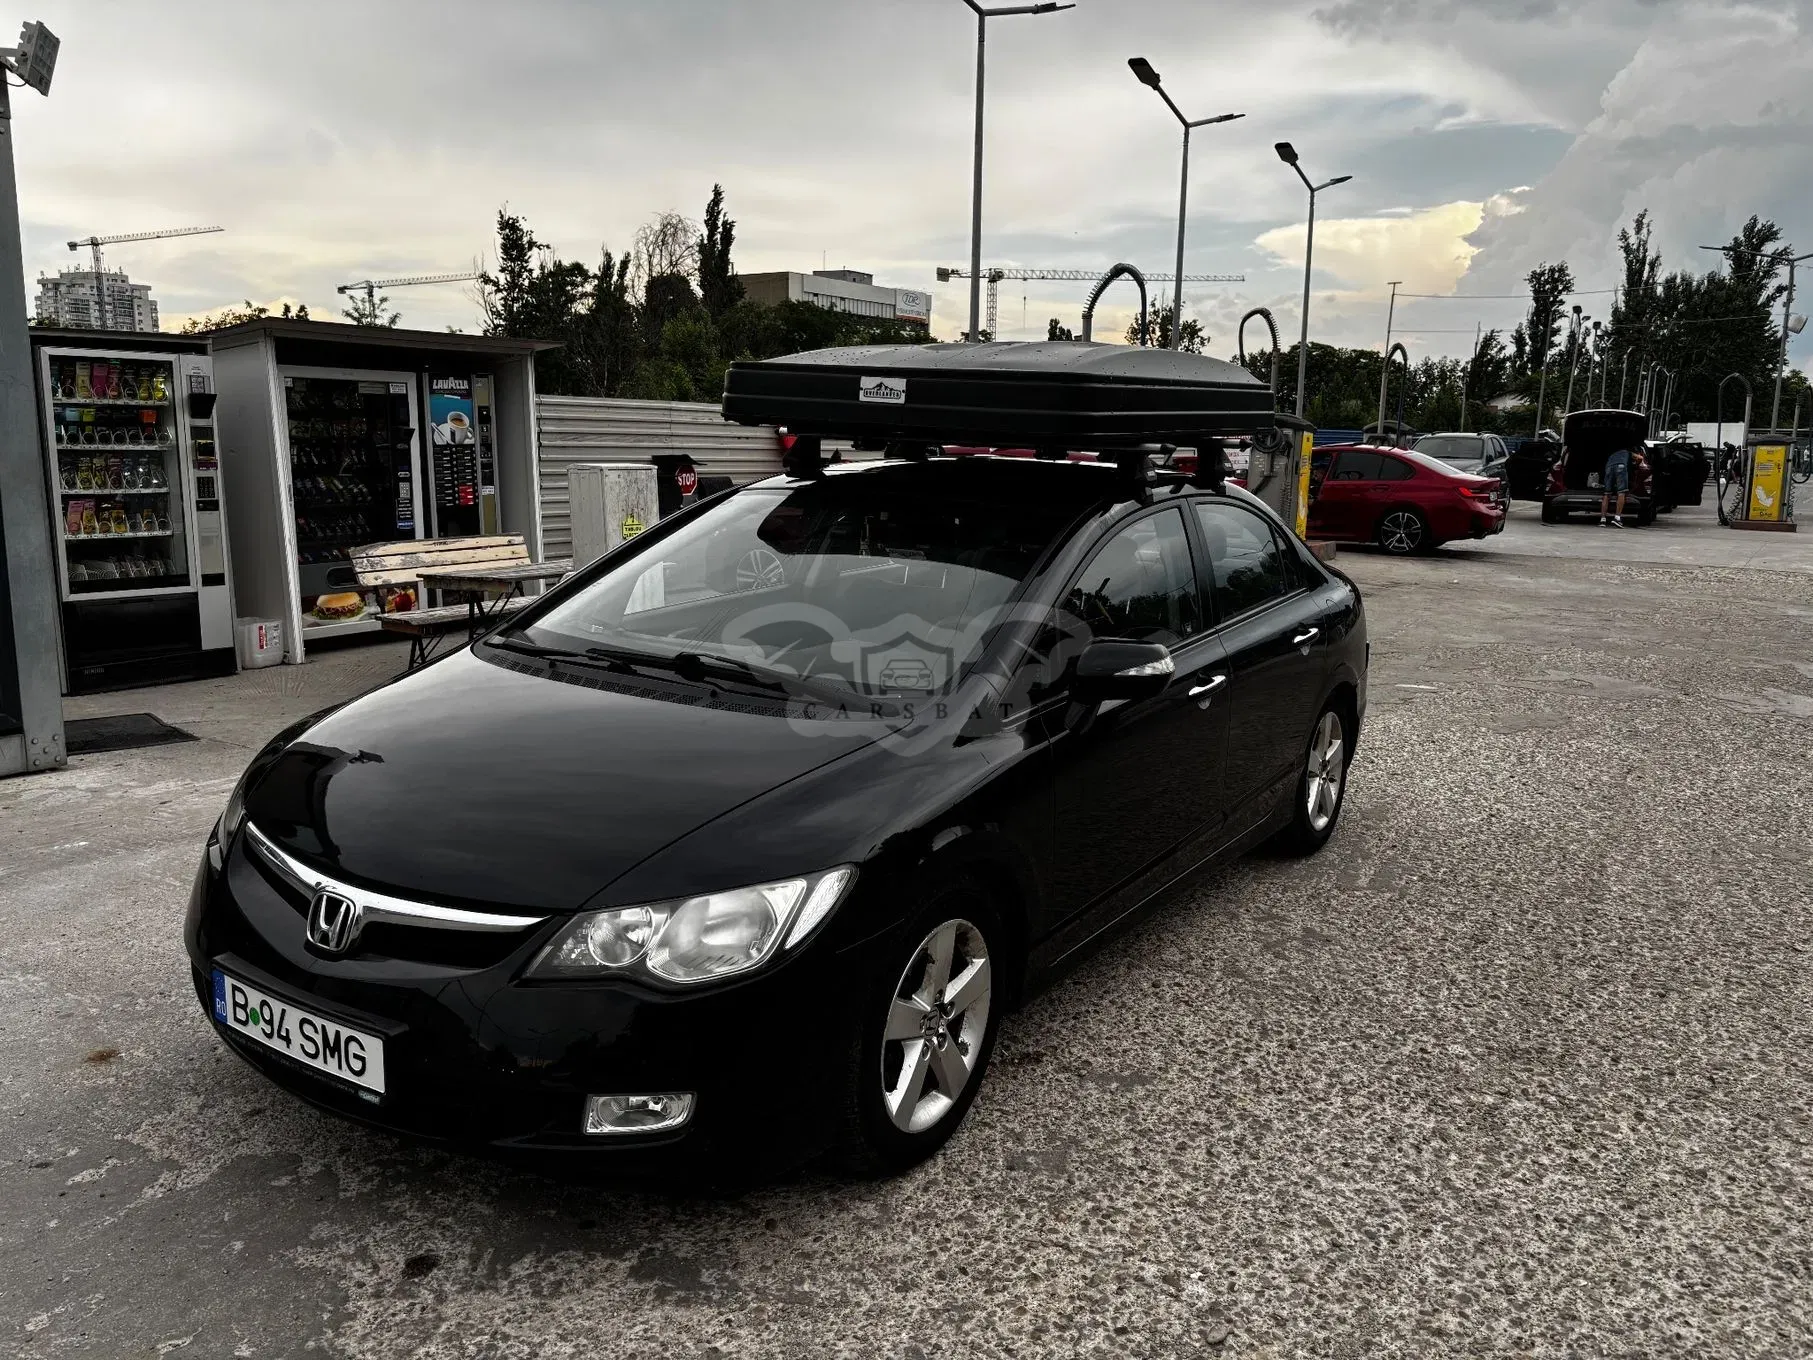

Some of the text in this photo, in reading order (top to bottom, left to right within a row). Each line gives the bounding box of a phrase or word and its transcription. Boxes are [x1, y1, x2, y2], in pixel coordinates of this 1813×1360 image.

[432, 377, 469, 390] LAVAZZA
[677, 473, 695, 486] STOP
[215, 998, 228, 1017] RO
[231, 983, 368, 1078] B 94 SMG
